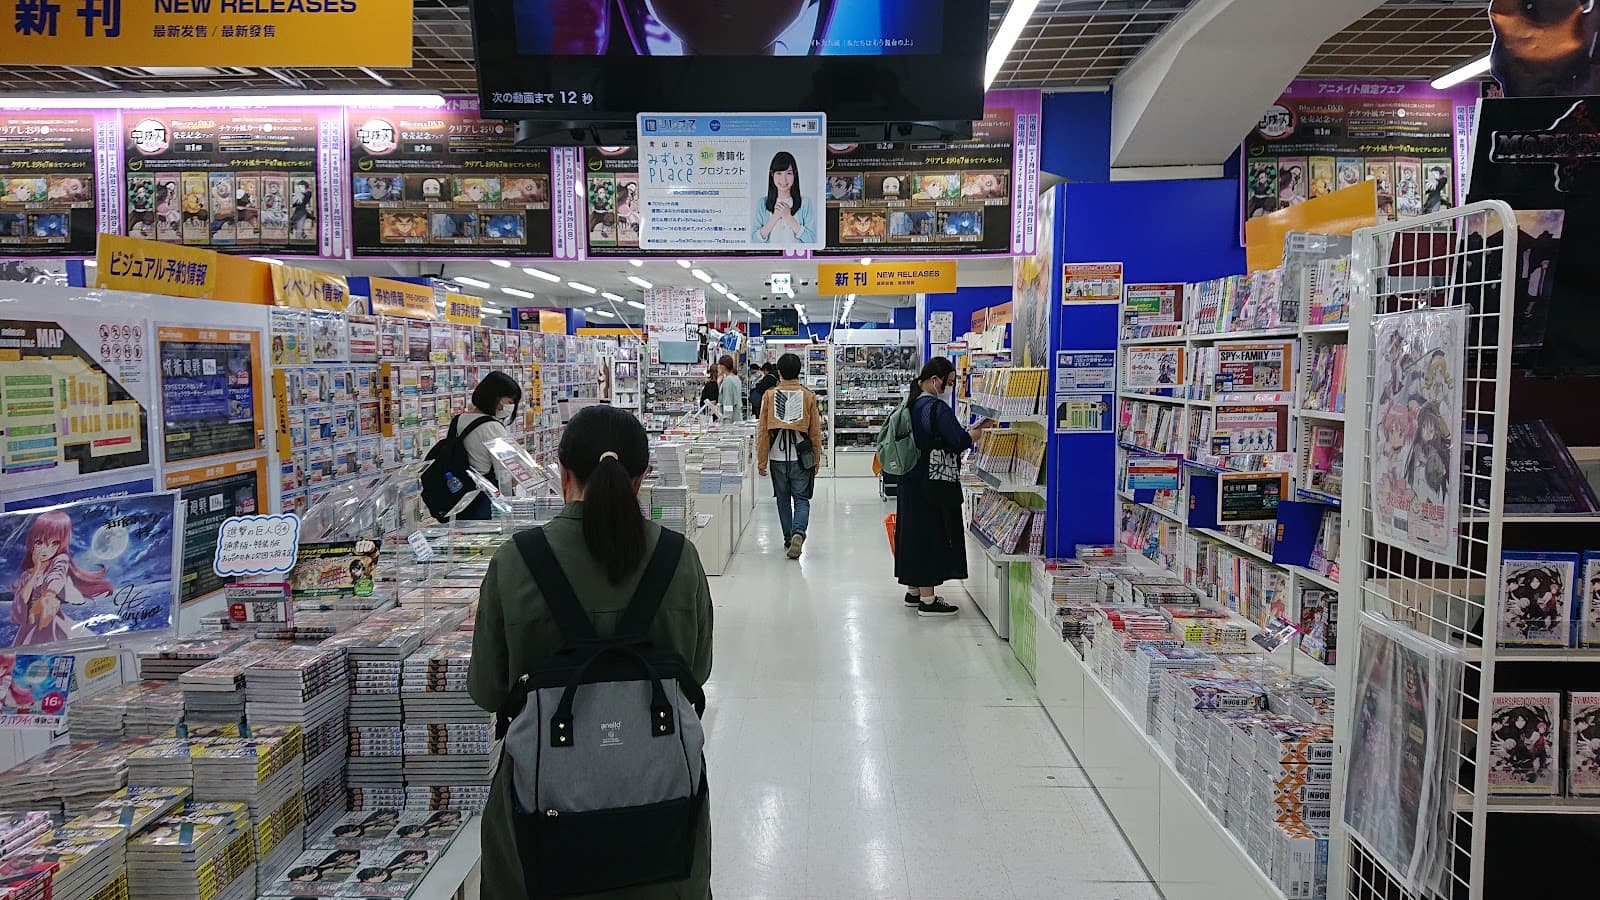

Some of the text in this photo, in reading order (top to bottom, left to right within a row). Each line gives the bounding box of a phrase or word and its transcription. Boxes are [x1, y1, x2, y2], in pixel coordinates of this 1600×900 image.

[154, 0, 357, 14] NEW RELEASES
[15, 0, 121, 38] 新刊
[153, 25, 208, 38] 最新发售
[221, 25, 276, 38] 最新發售
[492, 91, 594, 104] 次の動画まで 12 秒
[699, 167, 746, 175] プロジェクト
[110, 251, 208, 286] ビジュアル予約情報
[897, 270, 940, 278] RELEASES
[834, 271, 867, 287] 新刊
[36, 328, 65, 348] MAP
[45, 696, 58, 706] 16
